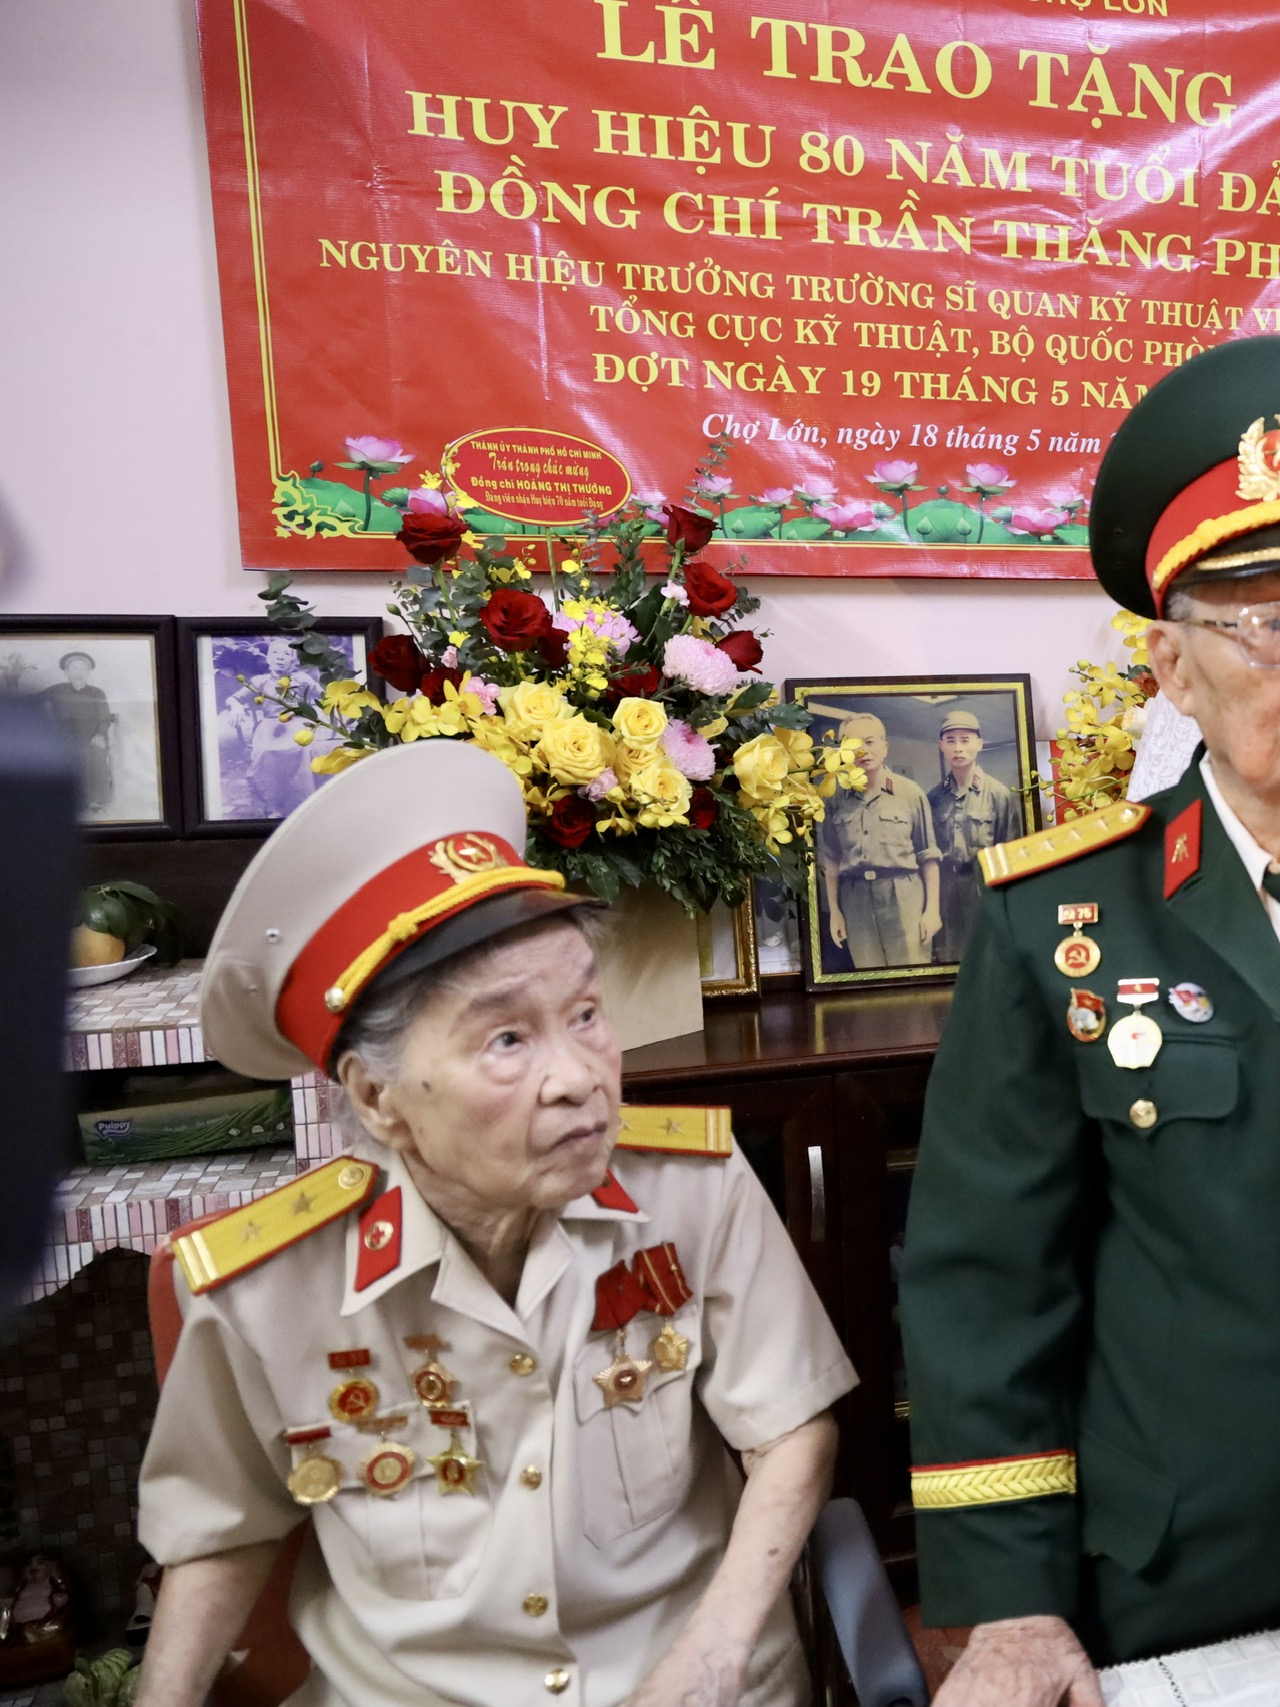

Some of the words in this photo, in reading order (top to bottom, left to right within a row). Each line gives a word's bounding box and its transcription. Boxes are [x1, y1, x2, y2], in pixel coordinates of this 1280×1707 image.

[751, 15, 993, 99] TRAO
[1019, 44, 1236, 130] TẶNG
[405, 91, 570, 151] HUY
[592, 104, 778, 176] HIỆU
[799, 131, 866, 177] 80
[886, 132, 1033, 194] NĂM
[1052, 145, 1200, 209] TUỔI
[434, 154, 642, 231] ĐỒNG
[663, 186, 784, 242] CHÍ
[803, 188, 976, 256] TRẦN
[993, 216, 1195, 273] THĂNG
[318, 238, 494, 278] NGUYÊN
[505, 250, 606, 292] HIỆU
[616, 256, 776, 300] TRƯỞNG
[786, 271, 936, 310] TRƯỜNG
[945, 279, 978, 314] SĨ
[988, 289, 1081, 321] QUAN
[1089, 291, 1132, 323] KỸ
[1141, 298, 1244, 336] THUẬT
[590, 294, 696, 339] TỔNG
[708, 313, 783, 349] CỤC
[794, 312, 842, 347] KỸ
[854, 319, 981, 360] THUẬT,
[990, 324, 1035, 364] BỘ
[1045, 326, 1134, 366] QUỐC
[1142, 335, 1218, 367] PHÒ
[592, 351, 689, 394] ĐỢT
[703, 354, 827, 396] NGÀY
[842, 369, 882, 398] 19
[893, 366, 1038, 406] THÁNG
[1050, 379, 1070, 407] 5
[470, 439, 499, 452] THÀNH
[511, 443, 539, 455] THÀNH
[539, 444, 556, 456] PHỐ
[568, 448, 582, 458] CHÍ
[582, 450, 602, 460] MINH
[702, 413, 760, 445] Chợ
[767, 418, 828, 449] Lớn,
[836, 421, 901, 452] ngày
[908, 423, 939, 448] 18
[945, 425, 1020, 456] tháng
[1026, 428, 1042, 452] 5
[1048, 431, 1101, 454] năm
[488, 451, 514, 472] Trân
[515, 458, 542, 479] trọng
[542, 457, 564, 475] chúc
[565, 460, 590, 482] mừng
[499, 478, 515, 489] chí
[516, 477, 553, 492] HOÀNG
[553, 482, 571, 496] THỊ
[98, 1119, 131, 1135] Pulppy
